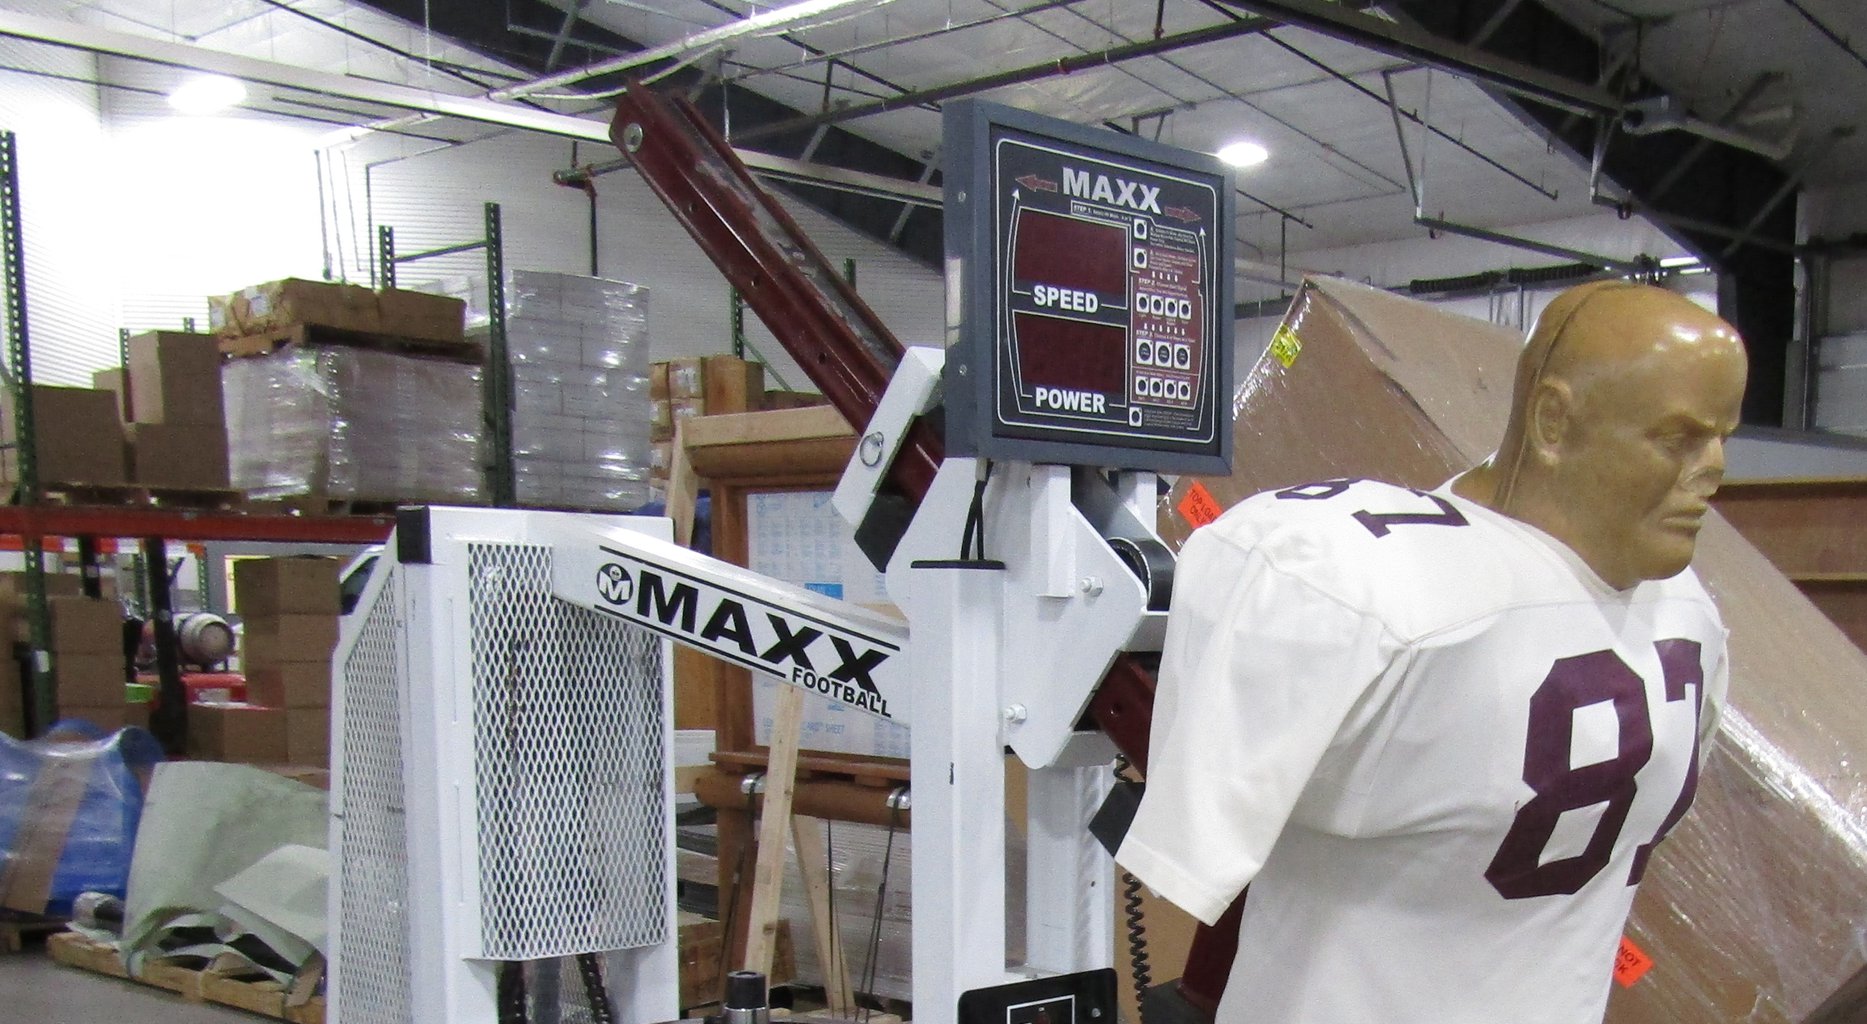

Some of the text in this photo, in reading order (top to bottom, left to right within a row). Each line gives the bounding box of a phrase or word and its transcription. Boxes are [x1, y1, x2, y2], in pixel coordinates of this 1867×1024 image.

[1062, 167, 1162, 215] MAXX
[1033, 285, 1099, 314] SPEED
[1035, 386, 1106, 414] POWER
[637, 569, 891, 701] MAXX
[792, 665, 893, 718] FOOTBALL
[1484, 638, 1704, 900] 87
